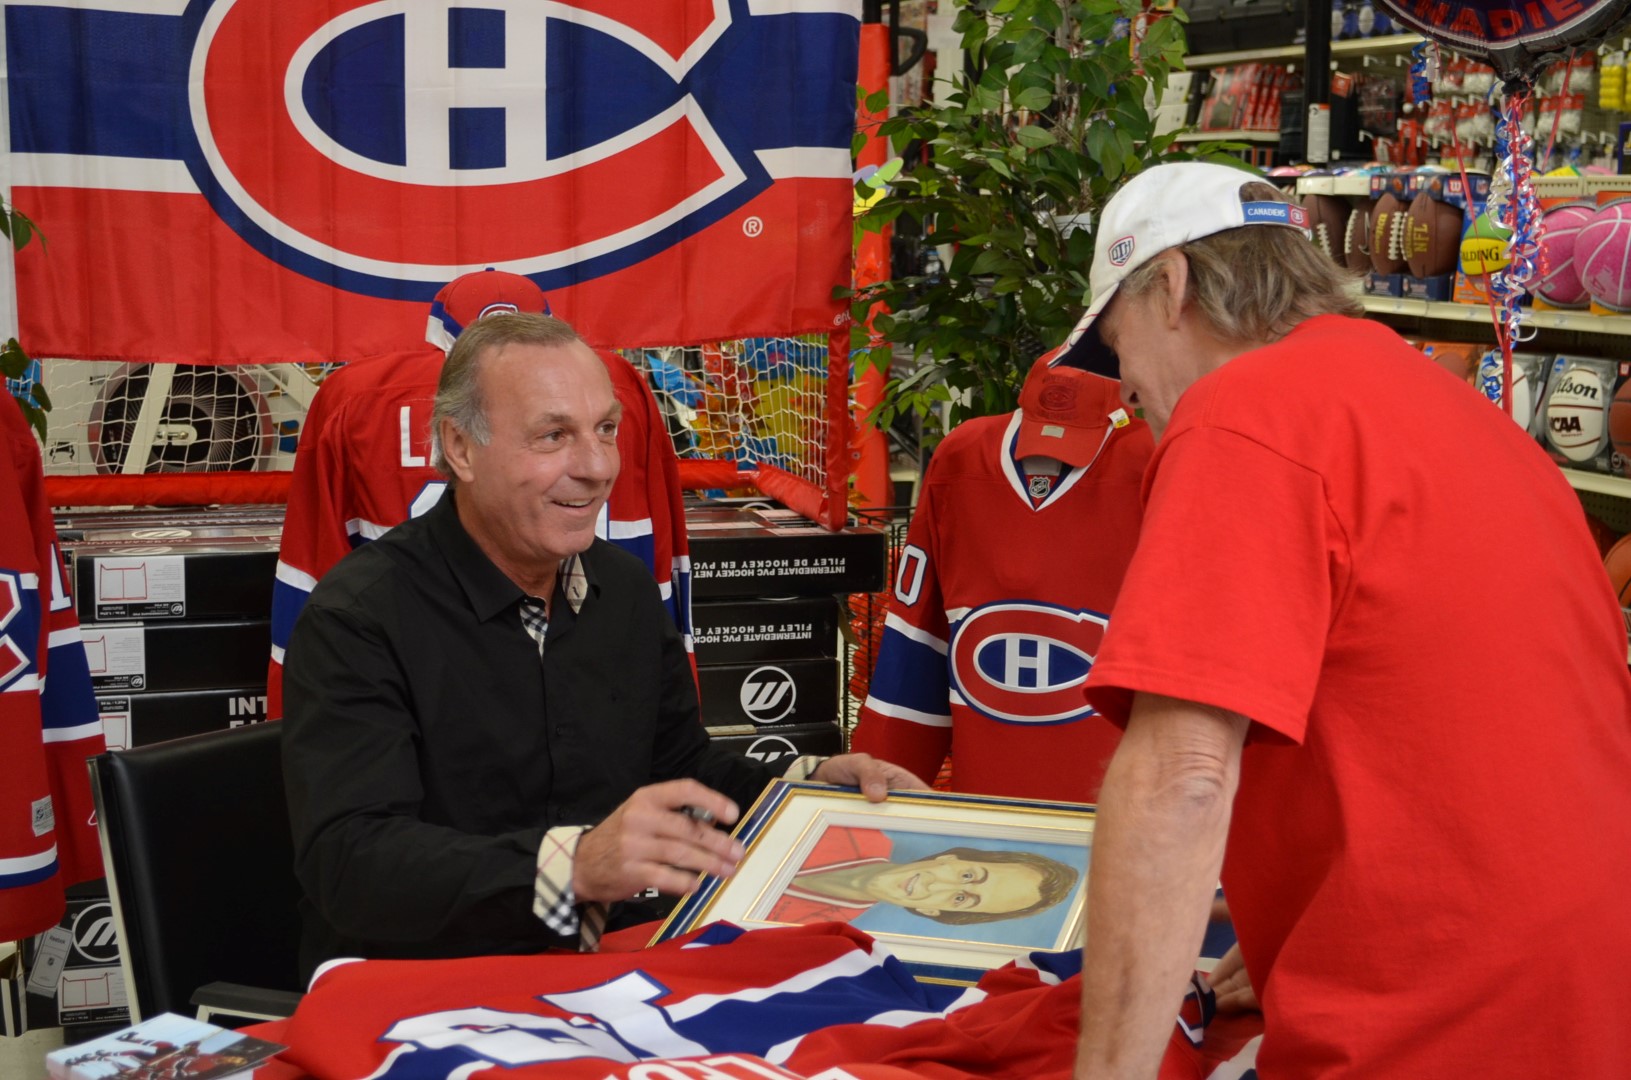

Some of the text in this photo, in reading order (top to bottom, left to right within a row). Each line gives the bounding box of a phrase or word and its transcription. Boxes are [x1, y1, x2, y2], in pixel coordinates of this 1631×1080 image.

[1247, 207, 1286, 218] CANADIENS
[693, 557, 846, 570] FILET DE HOCKEY EN PVC
[693, 566, 846, 579] INTERMEDIATE PVC HOCKEY NET
[707, 625, 755, 635] HOCKEY
[760, 625, 774, 633] DE
[780, 623, 812, 632] FILET
[722, 633, 741, 643] PVC
[743, 631, 812, 642] INTERMEDIATE
